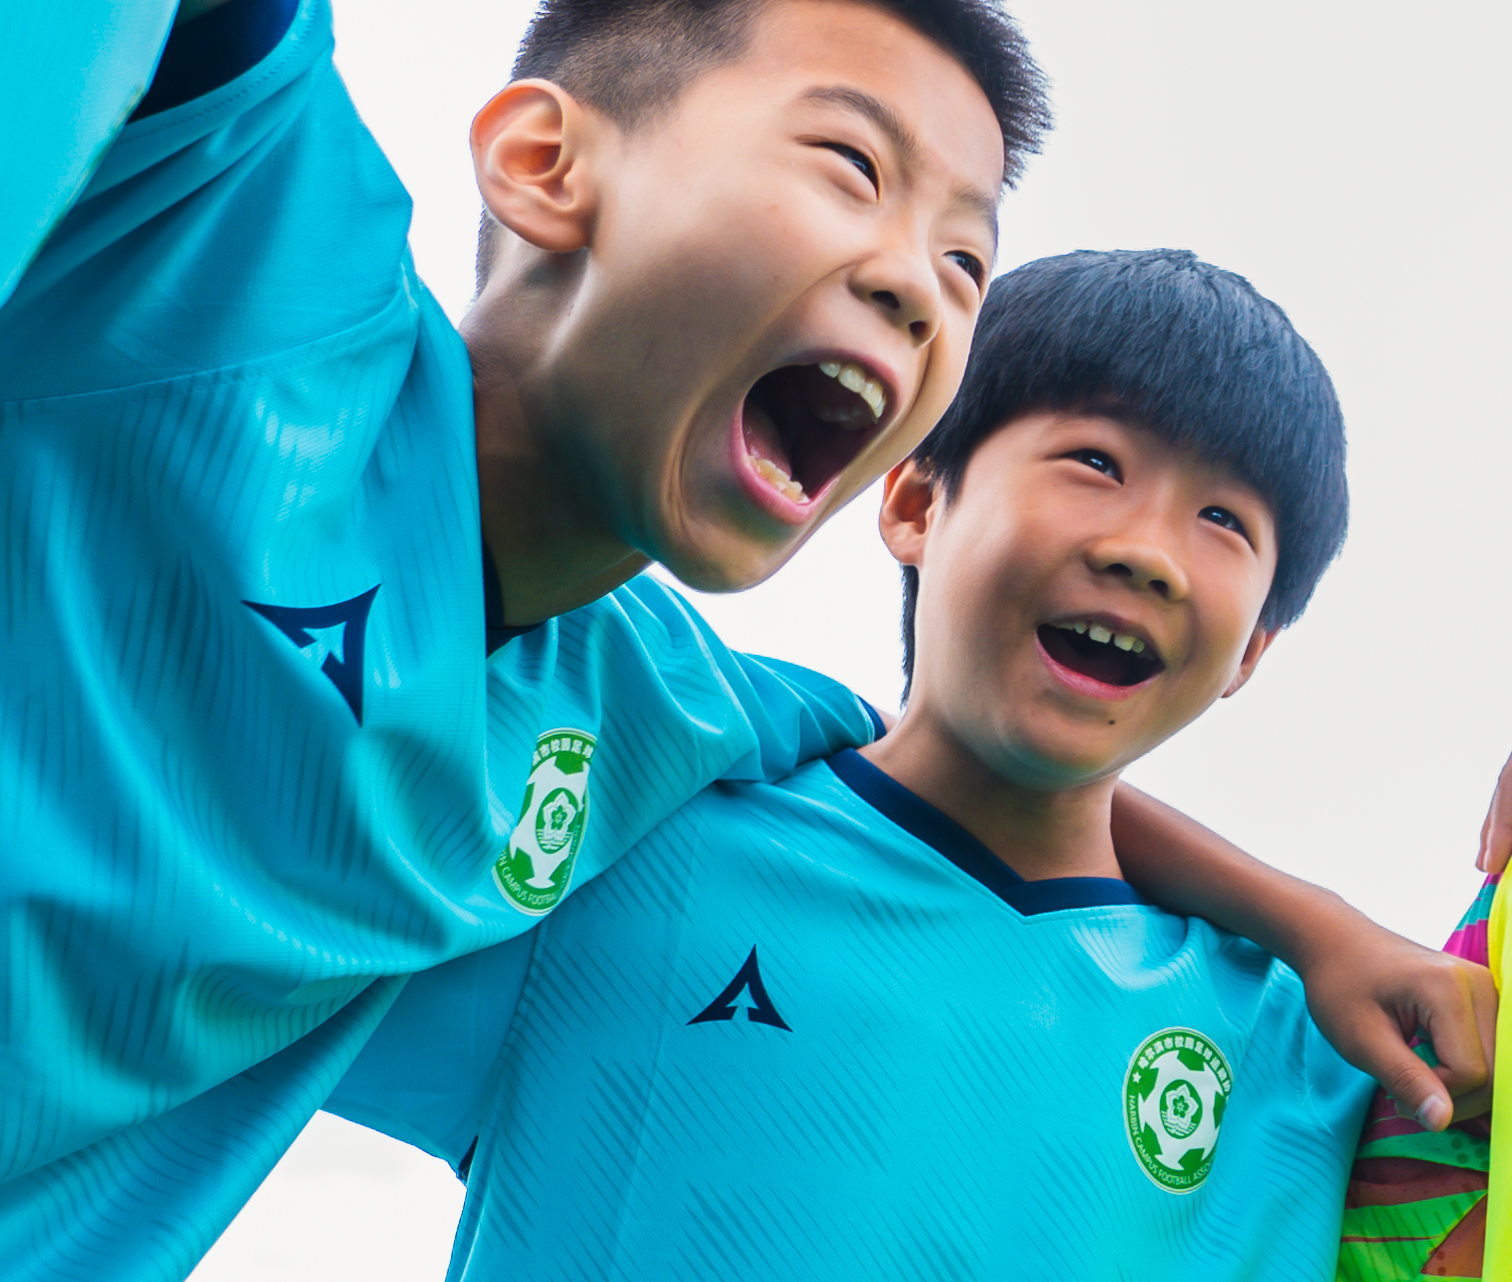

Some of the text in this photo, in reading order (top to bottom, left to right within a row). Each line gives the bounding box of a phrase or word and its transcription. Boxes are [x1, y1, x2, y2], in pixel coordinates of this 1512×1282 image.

[500, 866, 529, 901] CAMPUS
[1128, 1094, 1192, 1186] HARBIN CAMPUS FOOTBALL
